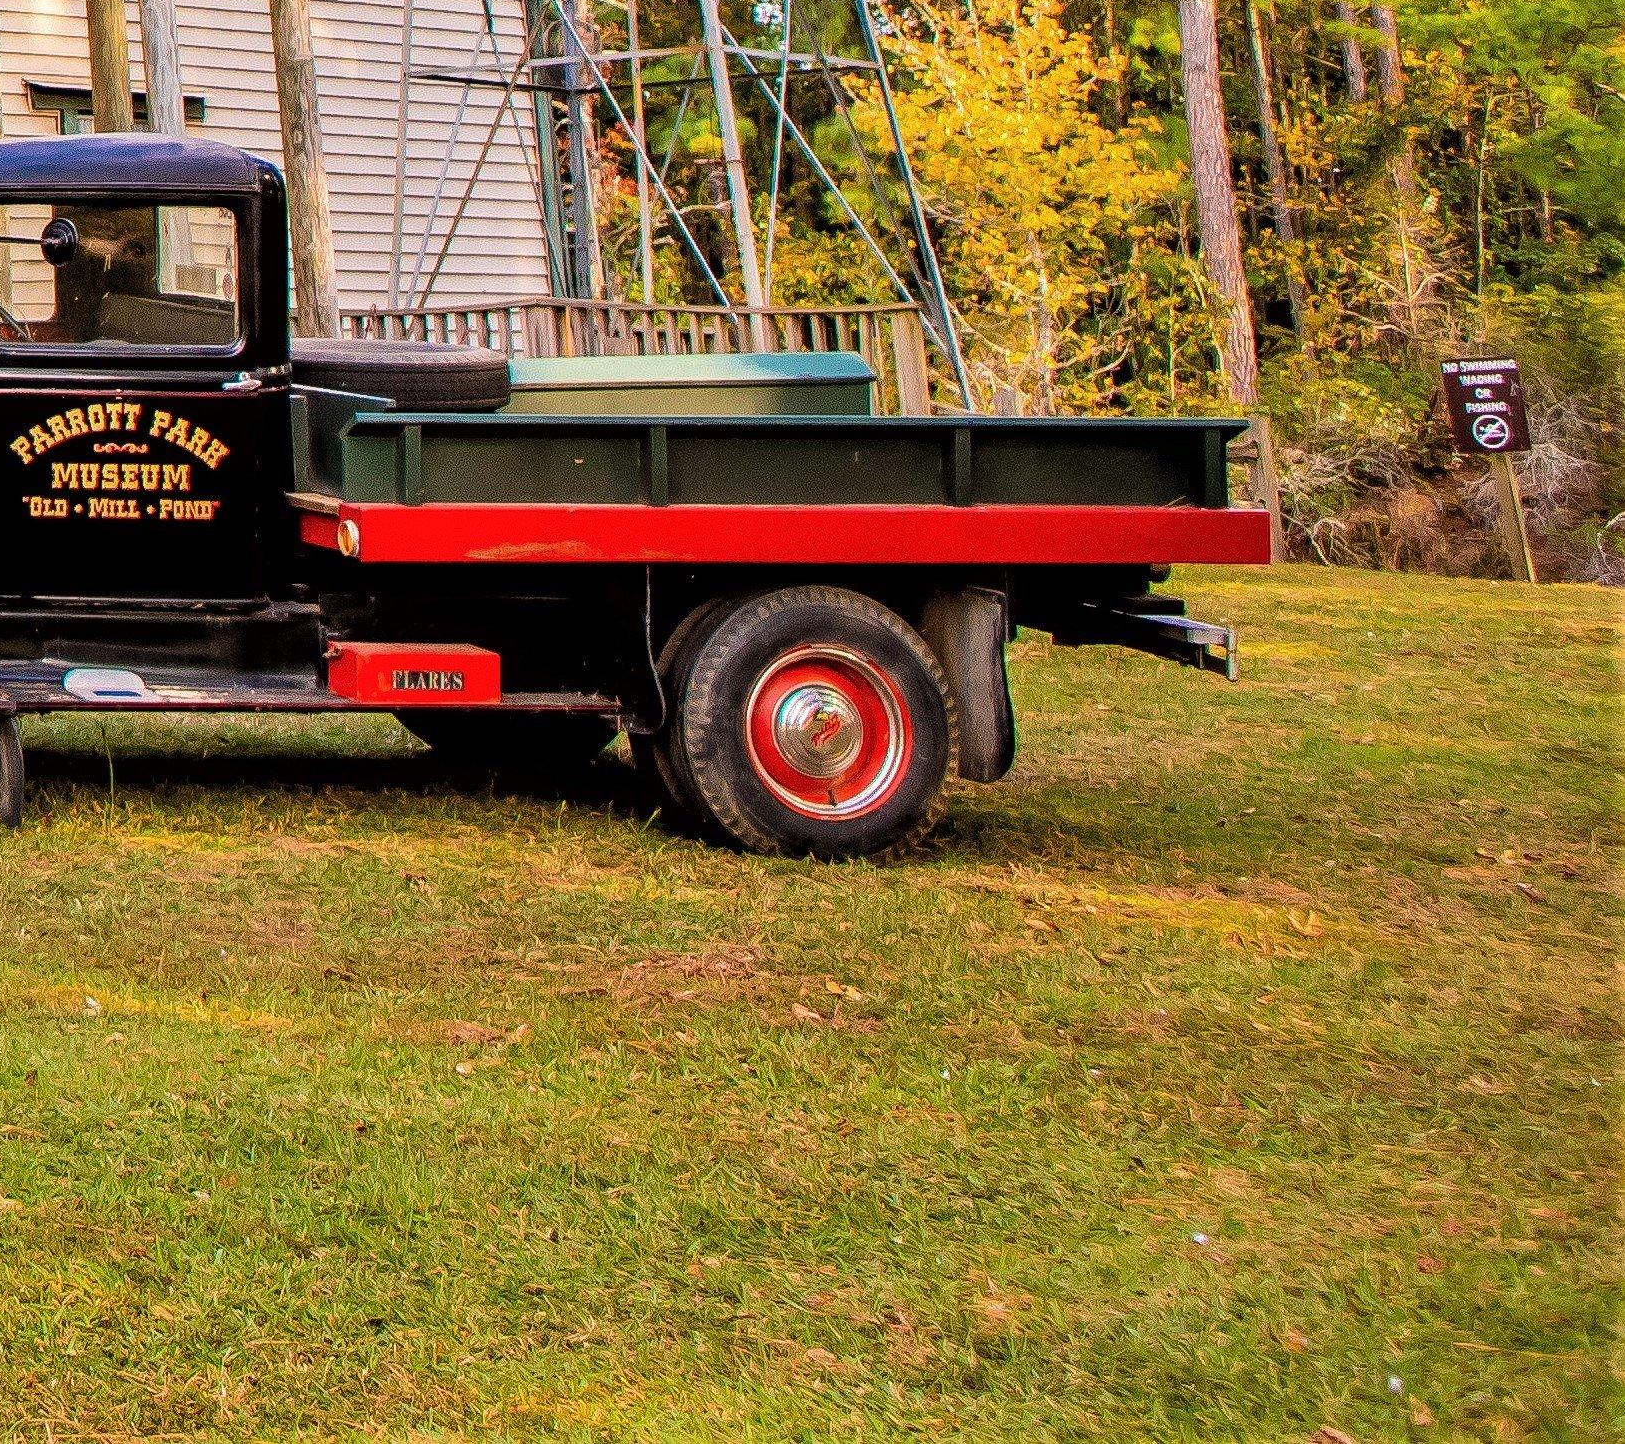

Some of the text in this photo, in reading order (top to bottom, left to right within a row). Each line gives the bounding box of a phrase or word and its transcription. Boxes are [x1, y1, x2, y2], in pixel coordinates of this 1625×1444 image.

[1441, 358, 1517, 373] NO SWIMMING
[1458, 373, 1505, 386] WADING
[1474, 387, 1493, 399] OR
[1464, 401, 1508, 413] FISHING
[10, 402, 231, 470] PARROTT PARK
[51, 462, 192, 491] MUSEUM
[88, 497, 142, 519] MILL
[392, 669, 464, 691] FLARES
